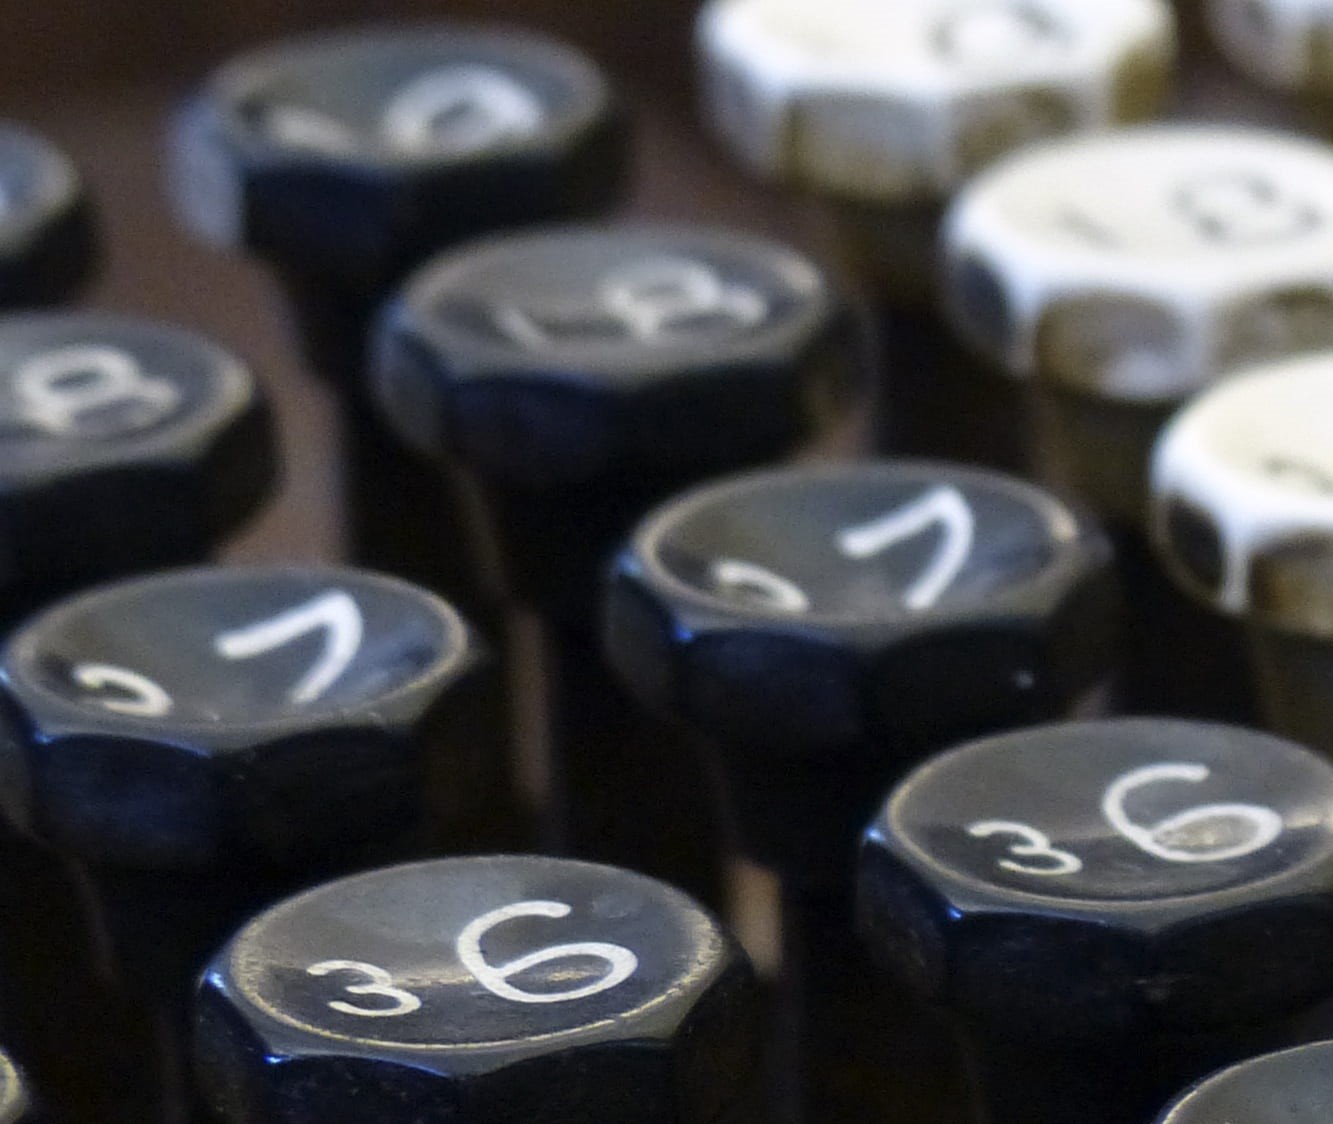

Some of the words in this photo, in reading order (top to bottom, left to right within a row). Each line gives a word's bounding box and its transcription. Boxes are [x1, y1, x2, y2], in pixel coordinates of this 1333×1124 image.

[836, 485, 974, 610] 7
[214, 590, 364, 704] 7
[968, 818, 1084, 875] 3
[1101, 762, 1285, 863] 6
[305, 958, 422, 1018] 3
[456, 900, 640, 1003] 6
